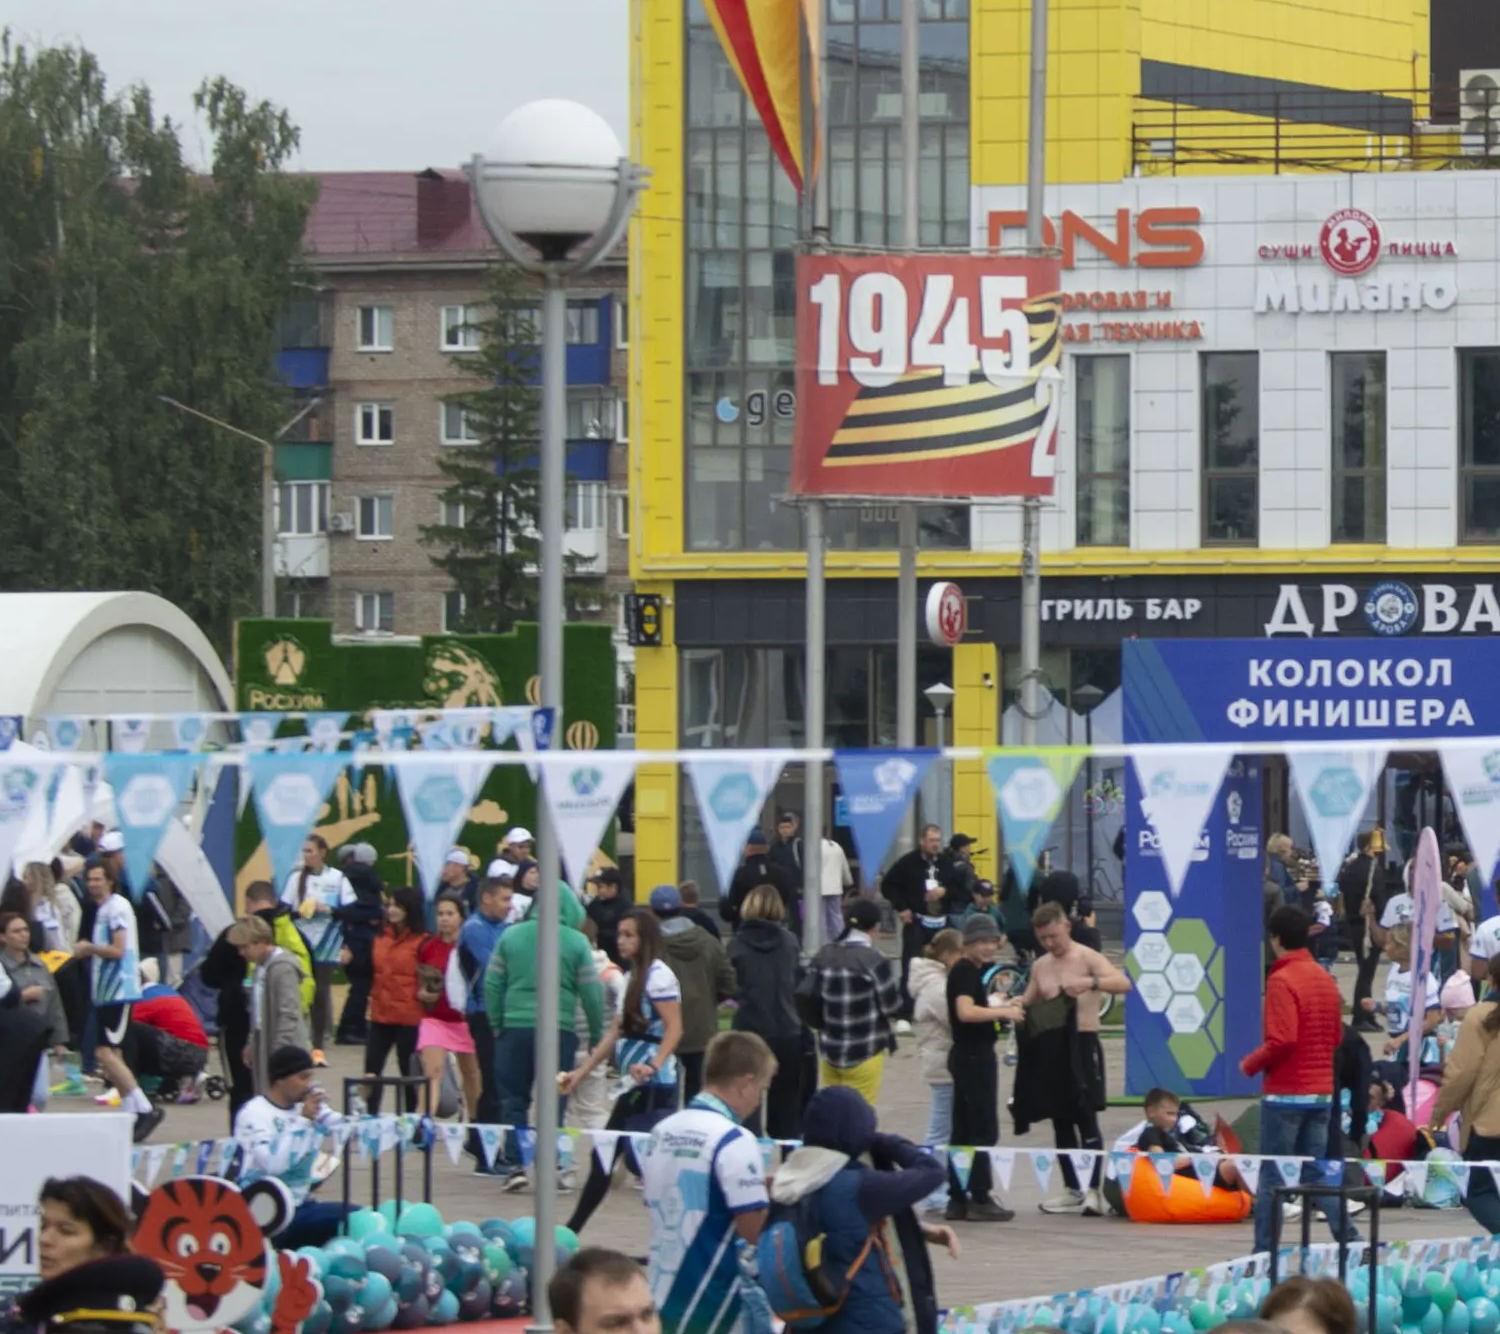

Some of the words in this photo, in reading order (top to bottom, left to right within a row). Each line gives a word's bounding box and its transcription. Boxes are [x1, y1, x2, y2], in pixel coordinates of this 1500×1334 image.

[988, 207, 1204, 269] DNS
[1258, 244, 1313, 260] СУШИ
[1388, 240, 1458, 258] ПИЦЦА
[809, 272, 1031, 388] 1945
[1102, 319, 1205, 342] ТЕХНИКА
[1041, 597, 1133, 621] ГРИЛЬ
[1146, 597, 1203, 620] БАР
[1248, 658, 1453, 687] КОЛОКОЛ
[1226, 697, 1475, 728] ФИНИШЕРА
